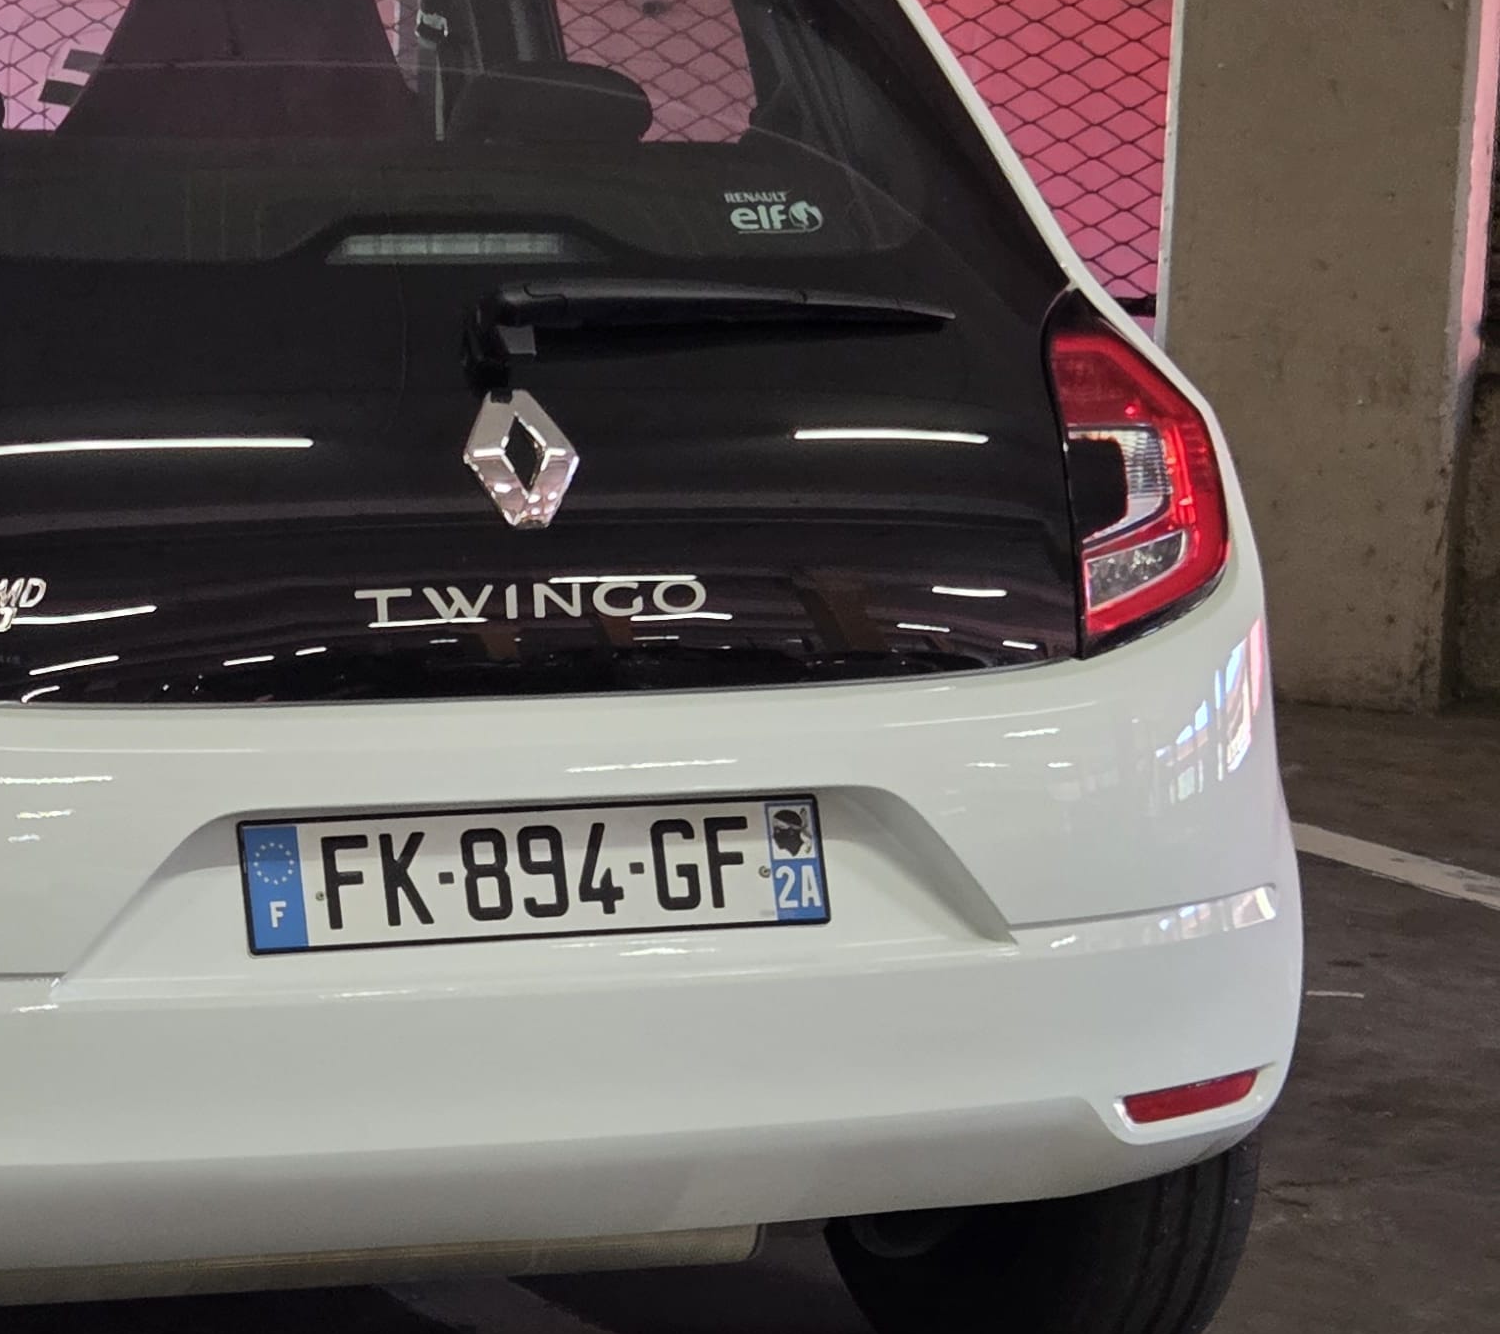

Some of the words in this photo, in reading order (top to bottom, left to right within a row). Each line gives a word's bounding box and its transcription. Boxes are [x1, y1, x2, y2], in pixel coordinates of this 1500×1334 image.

[723, 191, 790, 204] RENAULT
[730, 204, 789, 230] elf
[354, 581, 707, 623] TWINGO
[320, 815, 748, 931] FK-894-GF
[775, 864, 822, 908] 2A
[269, 900, 287, 928] F
